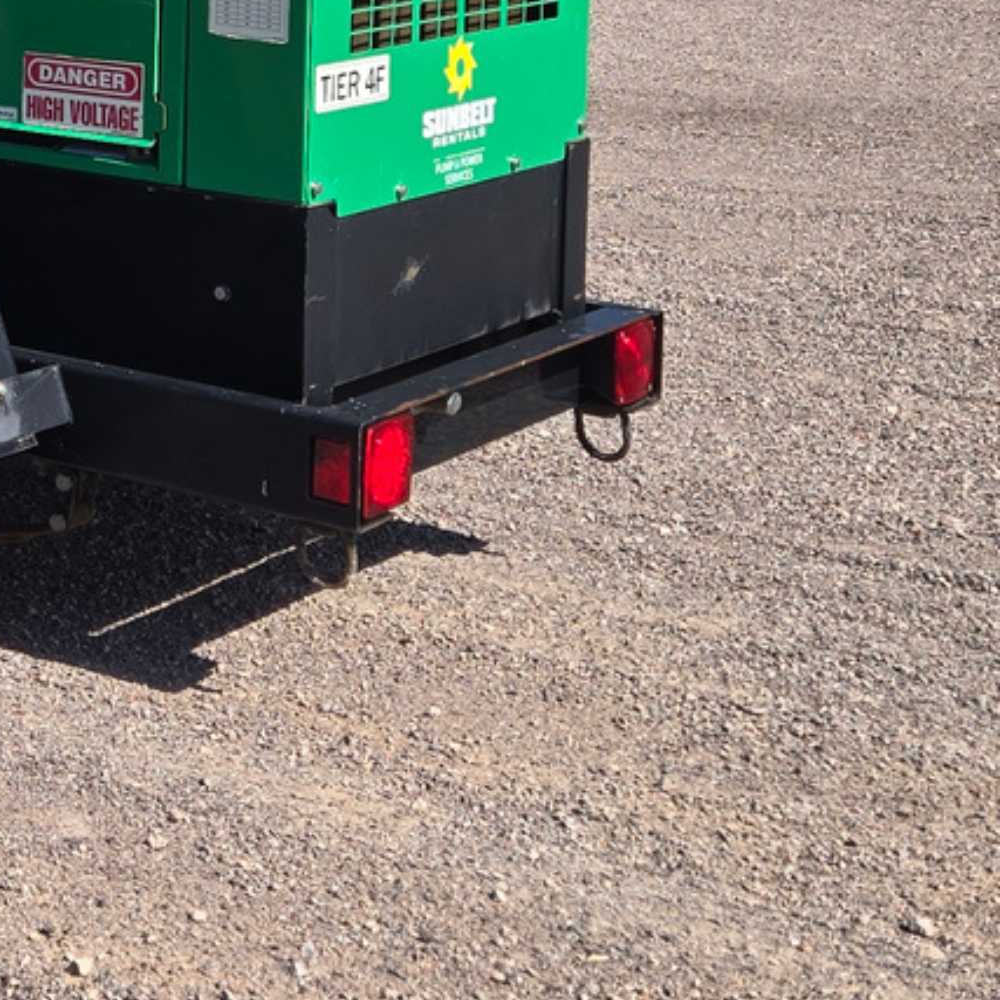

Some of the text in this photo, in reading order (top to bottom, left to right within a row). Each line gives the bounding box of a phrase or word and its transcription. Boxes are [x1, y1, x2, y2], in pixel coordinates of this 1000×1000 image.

[38, 64, 128, 91] DANGER
[320, 65, 386, 103] TIER 4F
[26, 95, 140, 132] HIGH VOLTAGE
[422, 97, 497, 139] SUNBELT
[432, 125, 486, 149] RENTALS
